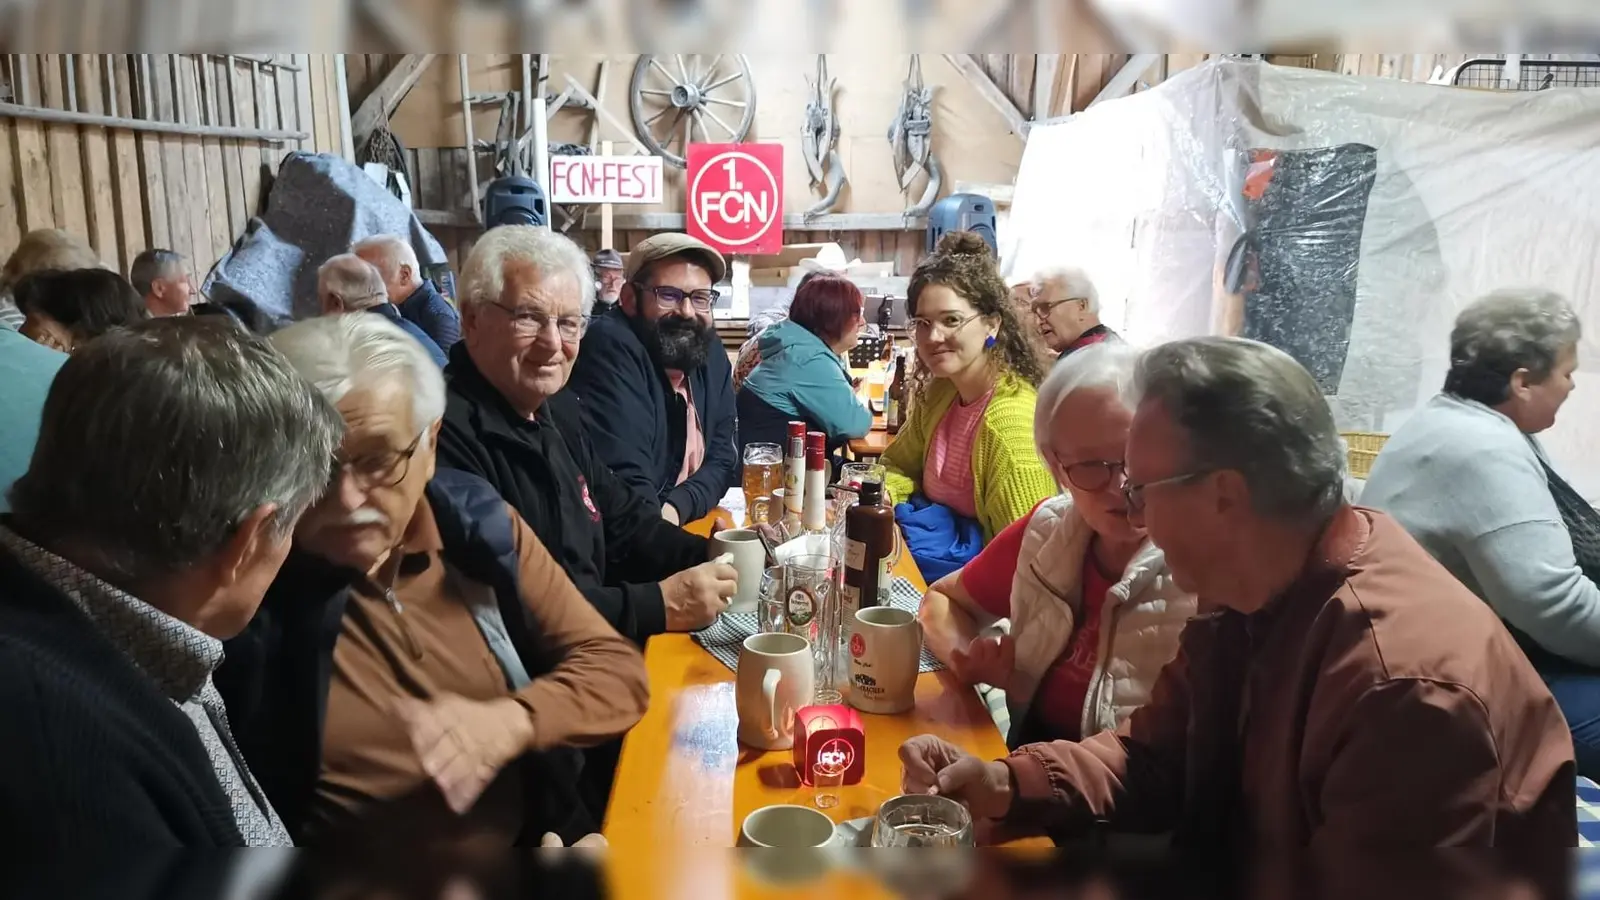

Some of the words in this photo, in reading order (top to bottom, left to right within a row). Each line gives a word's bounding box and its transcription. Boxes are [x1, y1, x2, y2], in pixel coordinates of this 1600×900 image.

[552, 161, 659, 199] FCN-FEST
[722, 158, 743, 190] 1.
[701, 190, 767, 224] FCN
[821, 751, 851, 765] FCN
